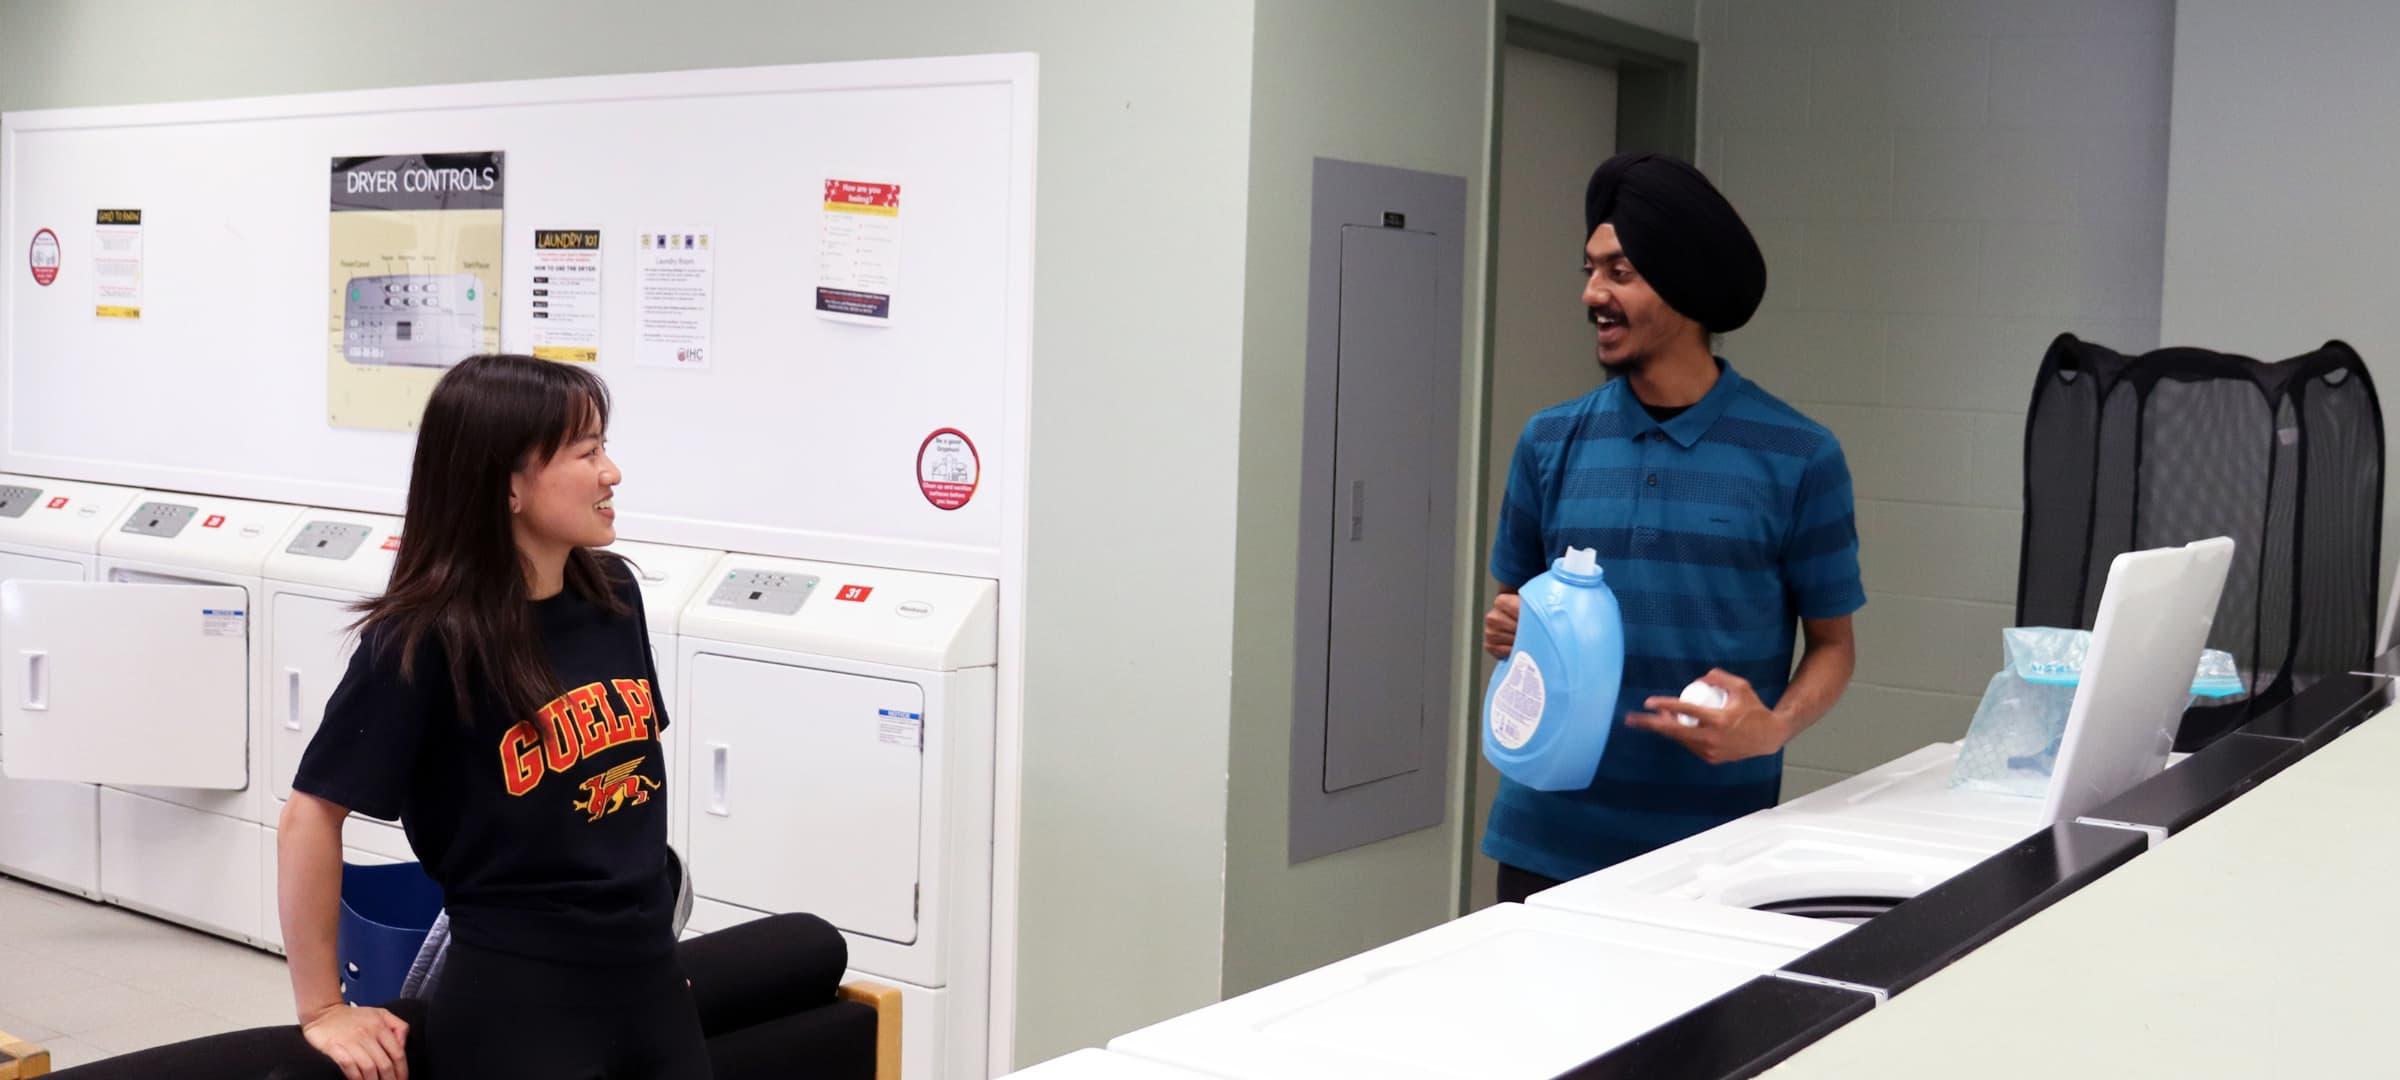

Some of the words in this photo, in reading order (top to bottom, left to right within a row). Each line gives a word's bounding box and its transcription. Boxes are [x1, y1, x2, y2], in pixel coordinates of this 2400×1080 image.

[347, 170, 398, 194] DRYER
[403, 167, 494, 192] CONTROLS
[842, 183, 856, 192] How
[868, 187, 882, 195] you
[848, 193, 873, 205] feeling?
[538, 232, 582, 248] LAUNDRY
[584, 233, 598, 247] 101
[845, 588, 862, 599] 31
